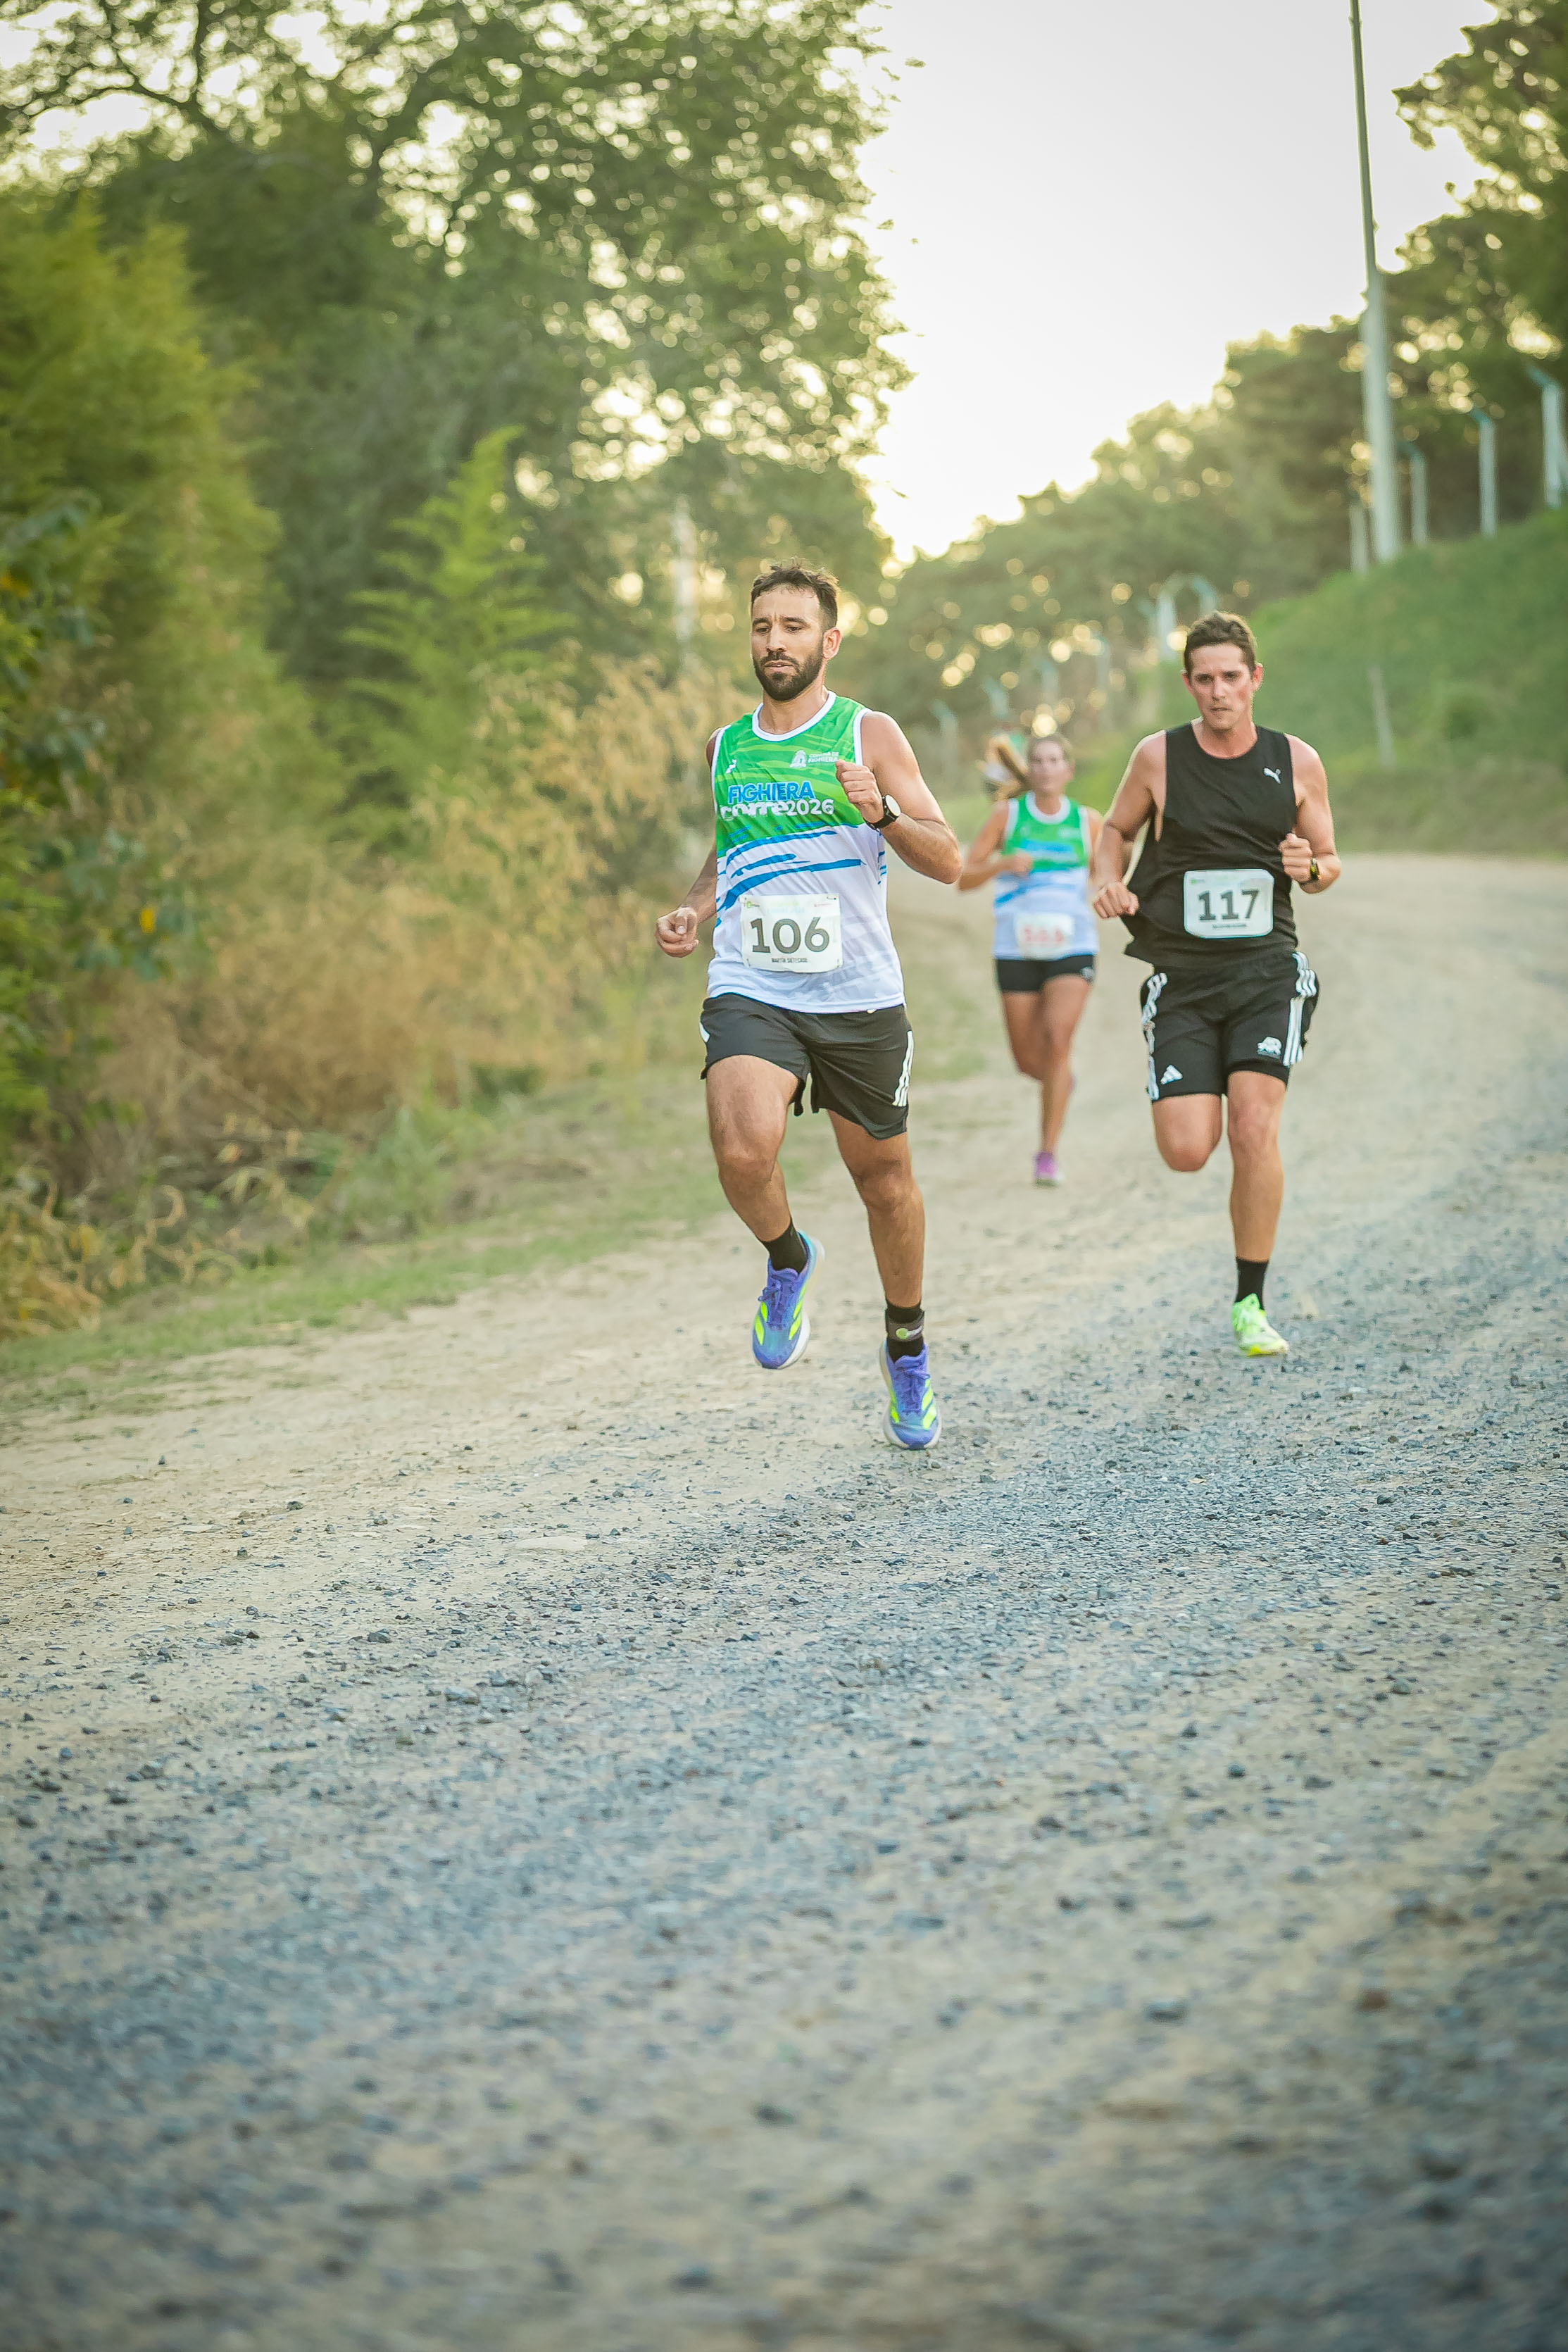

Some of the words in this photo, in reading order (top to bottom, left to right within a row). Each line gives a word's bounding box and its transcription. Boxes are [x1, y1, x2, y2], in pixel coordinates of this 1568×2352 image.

[728, 781, 815, 804] FIGHIERA
[1198, 889, 1260, 920] 117
[750, 917, 829, 954] 106
